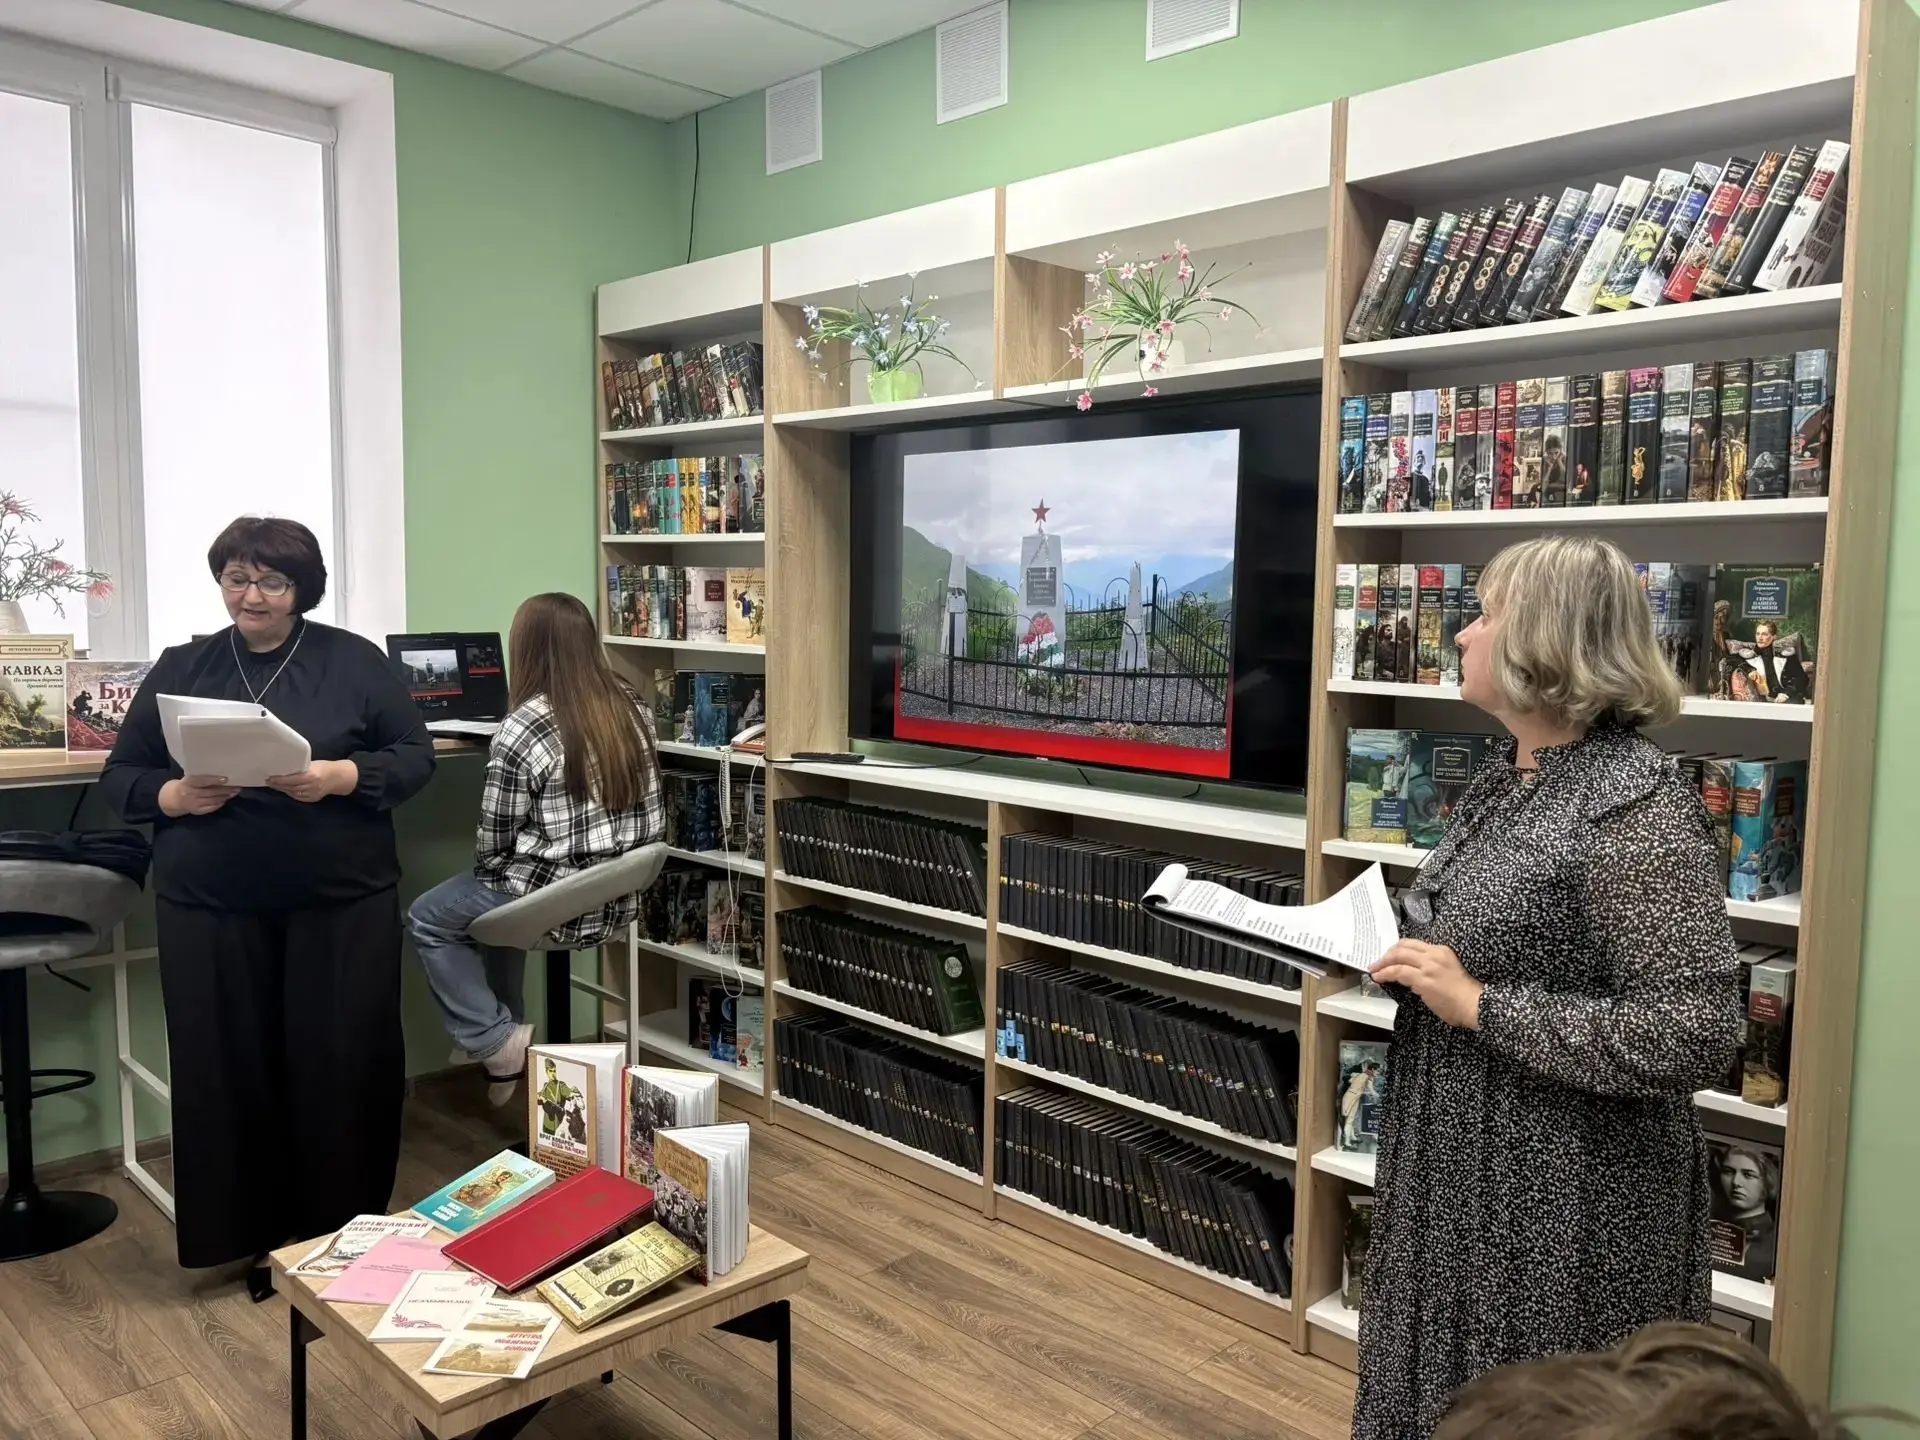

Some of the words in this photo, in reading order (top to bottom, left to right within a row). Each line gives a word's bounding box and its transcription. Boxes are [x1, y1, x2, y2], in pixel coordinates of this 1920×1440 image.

[1379, 253, 1396, 283] САГА
[2, 665, 63, 676] КАВКАЗ
[539, 1132, 552, 1141] ВРАГ
[350, 1220, 429, 1228] ПАРТИЗАНСКИЙ
